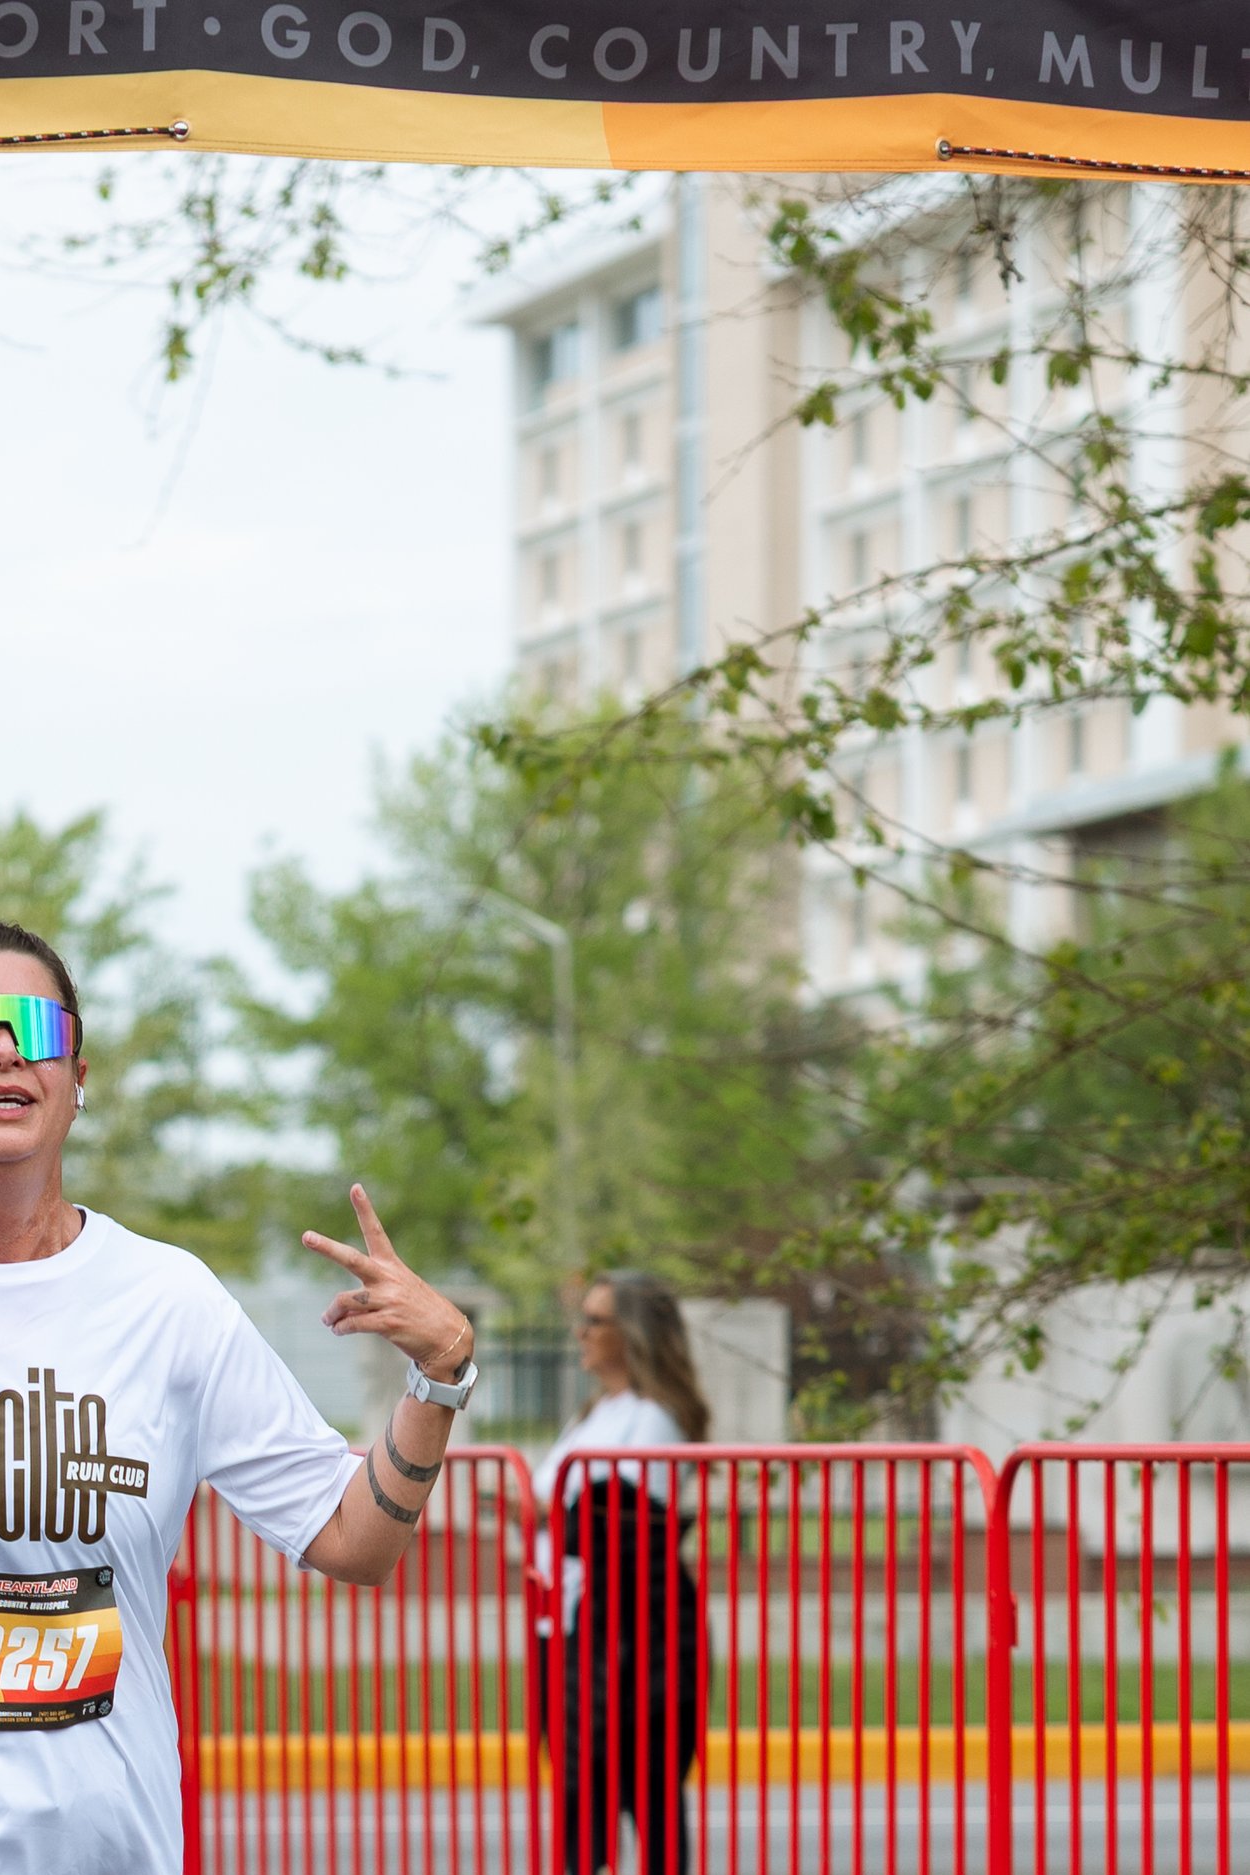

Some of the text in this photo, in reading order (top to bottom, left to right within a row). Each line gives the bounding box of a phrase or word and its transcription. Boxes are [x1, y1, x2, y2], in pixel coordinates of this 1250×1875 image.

[261, 4, 480, 79] GOD,
[529, 20, 995, 82] COUNTRY,
[1038, 31, 1250, 98] MUL
[66, 1461, 146, 1488] RUN CLUB
